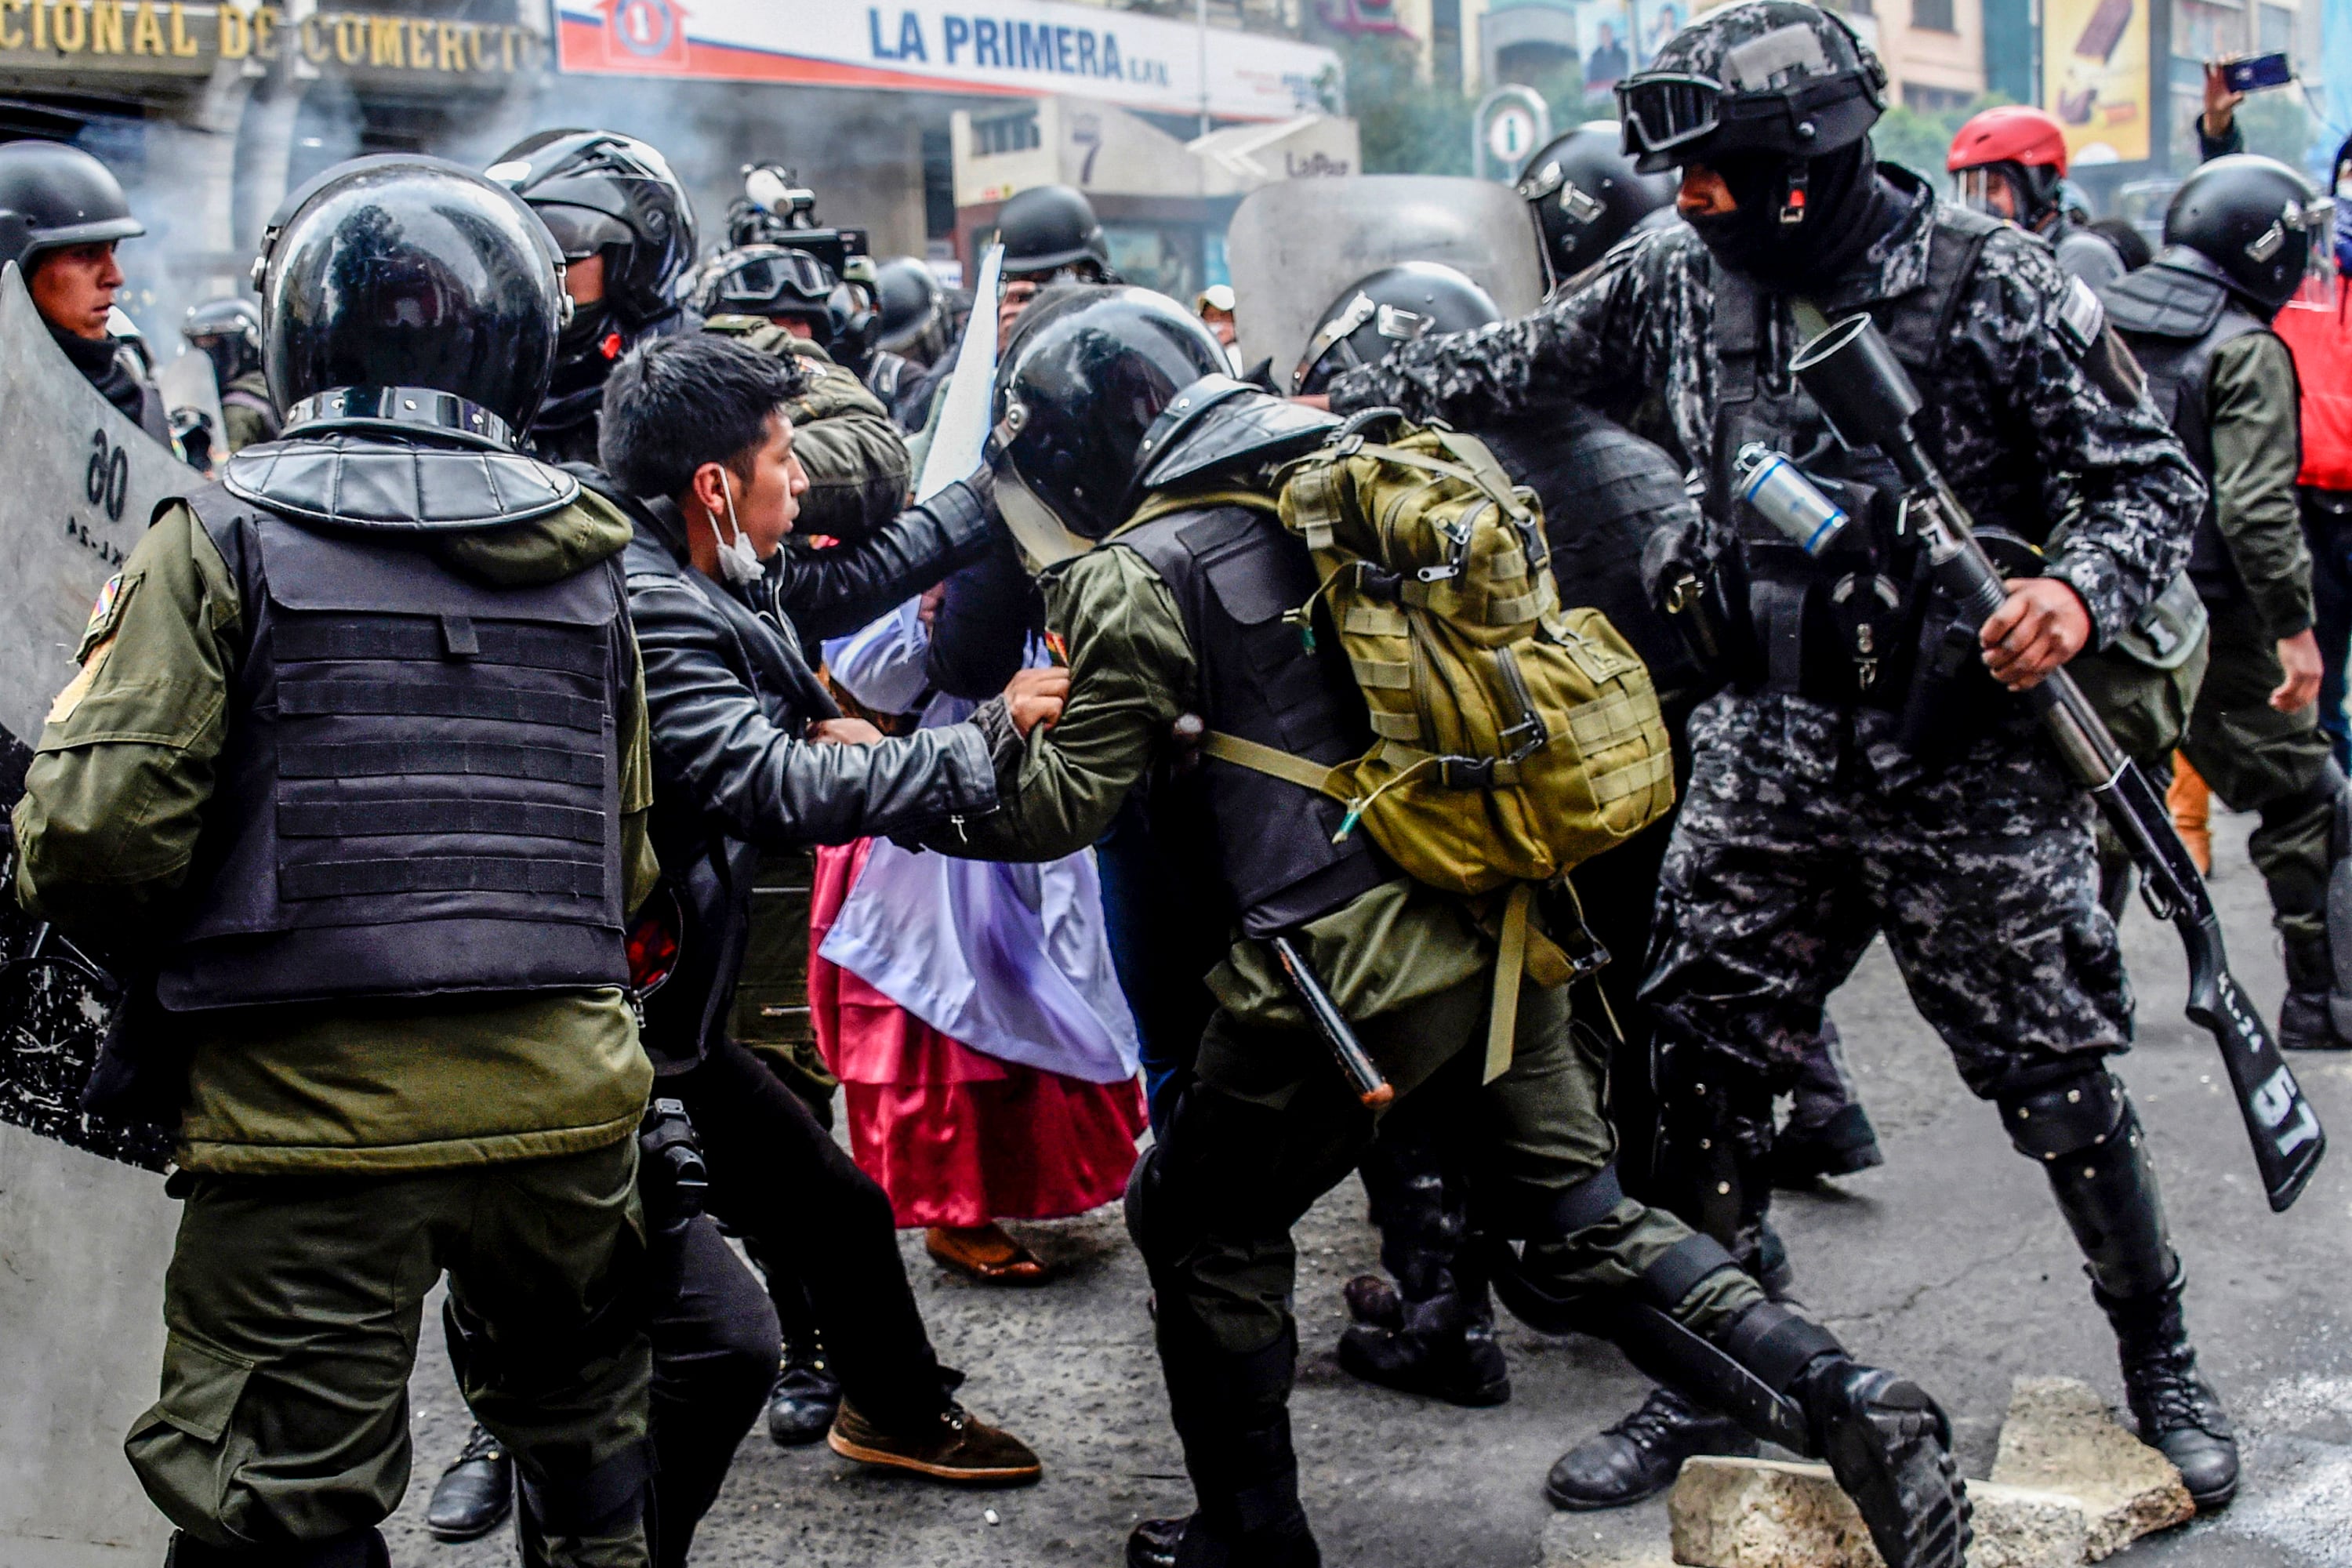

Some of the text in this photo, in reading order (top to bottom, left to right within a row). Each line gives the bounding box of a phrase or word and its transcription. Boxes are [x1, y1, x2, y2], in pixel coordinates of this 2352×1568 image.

[0, 0, 198, 56] CIONAL
[218, 4, 278, 58] DE
[869, 7, 927, 62] LA
[943, 15, 1123, 82] PRIMERA
[2252, 1063, 2321, 1157] 57
